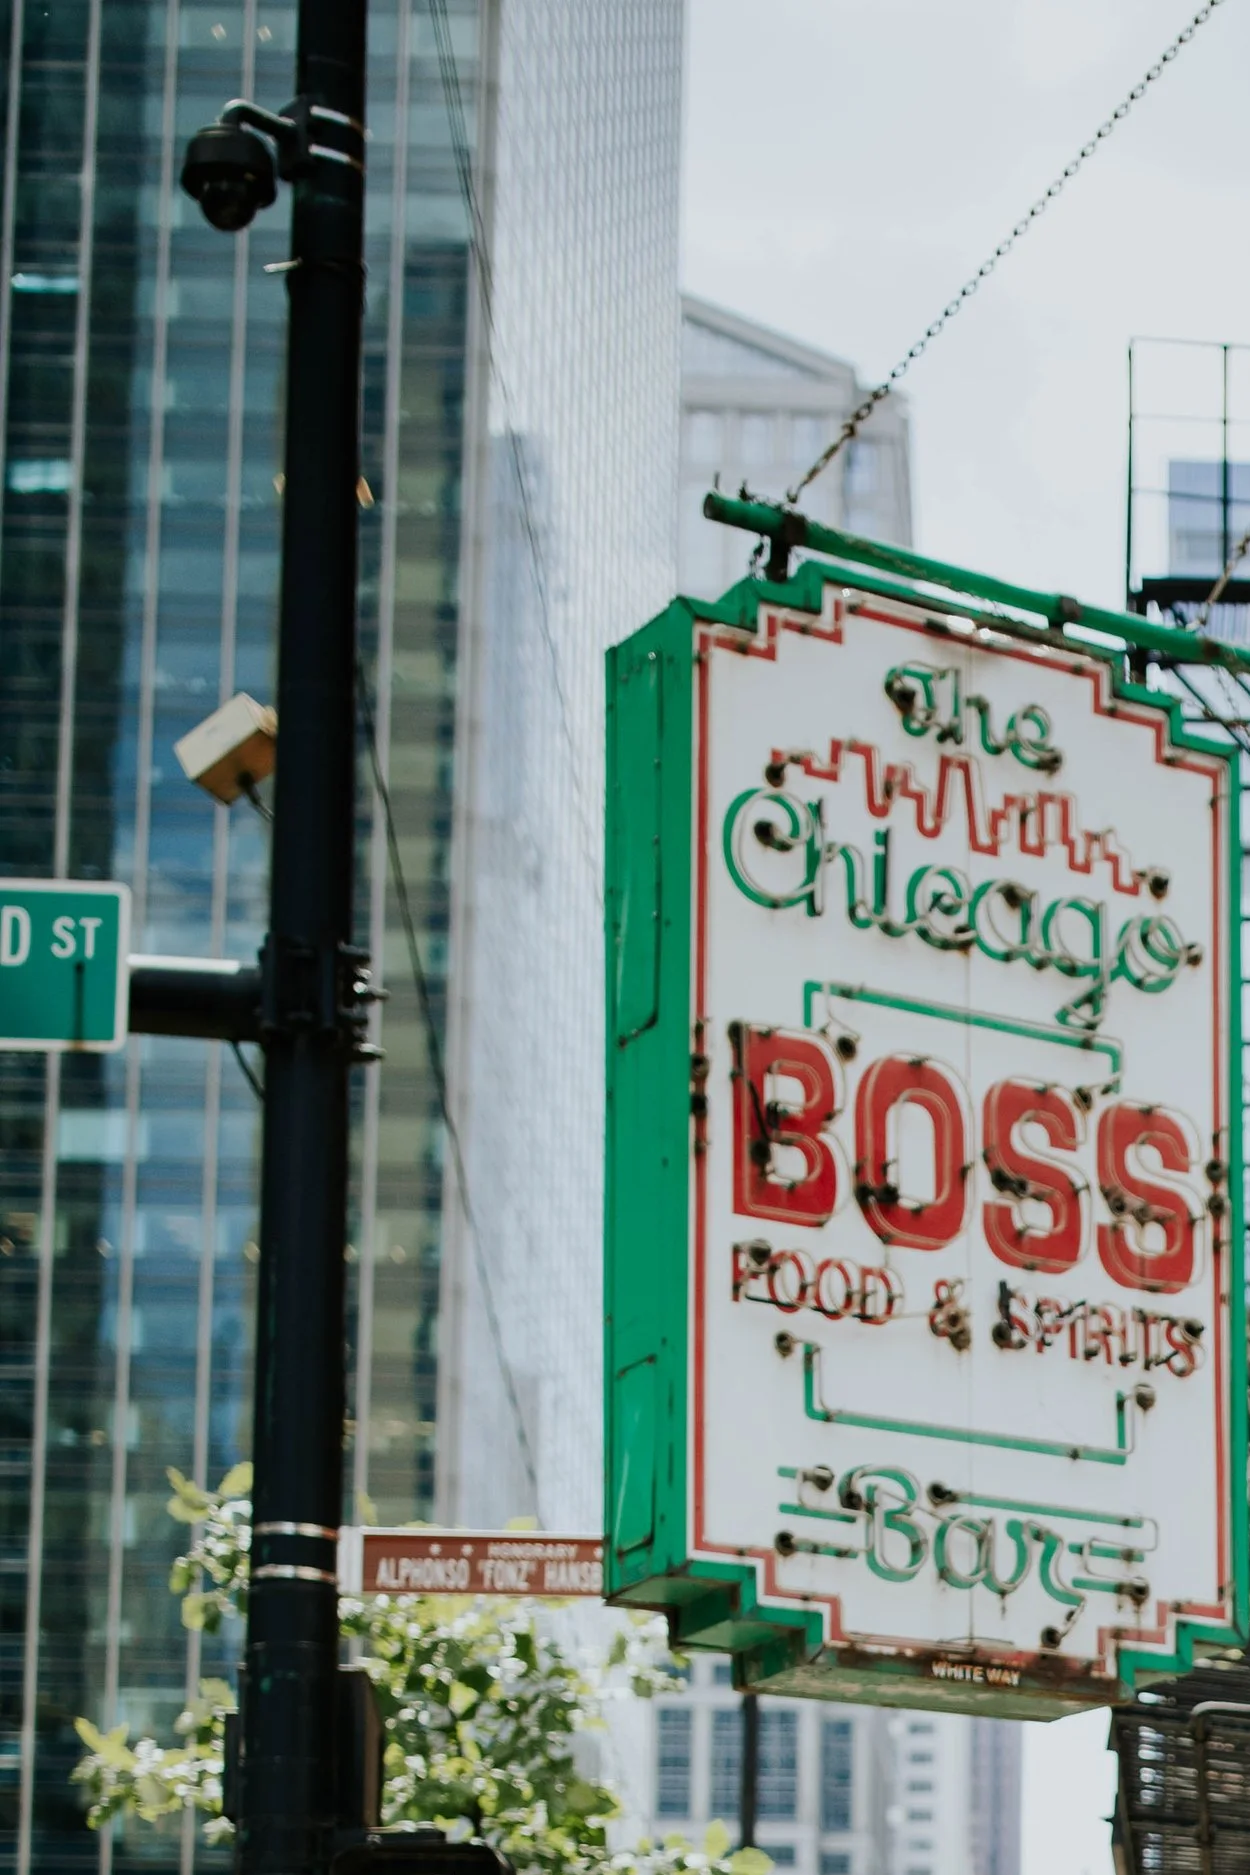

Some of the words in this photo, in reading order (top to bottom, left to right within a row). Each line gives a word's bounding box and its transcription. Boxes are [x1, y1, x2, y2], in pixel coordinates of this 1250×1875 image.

[885, 660, 1062, 777] The
[51, 915, 103, 960] ST
[722, 787, 1194, 1029] Chicago
[731, 1022, 1200, 1295] BOSS
[731, 1243, 901, 1326] FOOD
[928, 1278, 970, 1344] &
[998, 1282, 1204, 1377] SPIRITS
[375, 1557, 471, 1591] ALPHONSO
[838, 1464, 1087, 1607] Bar
[931, 1660, 984, 1683] WHITE
[986, 1667, 1020, 1687] WAY
